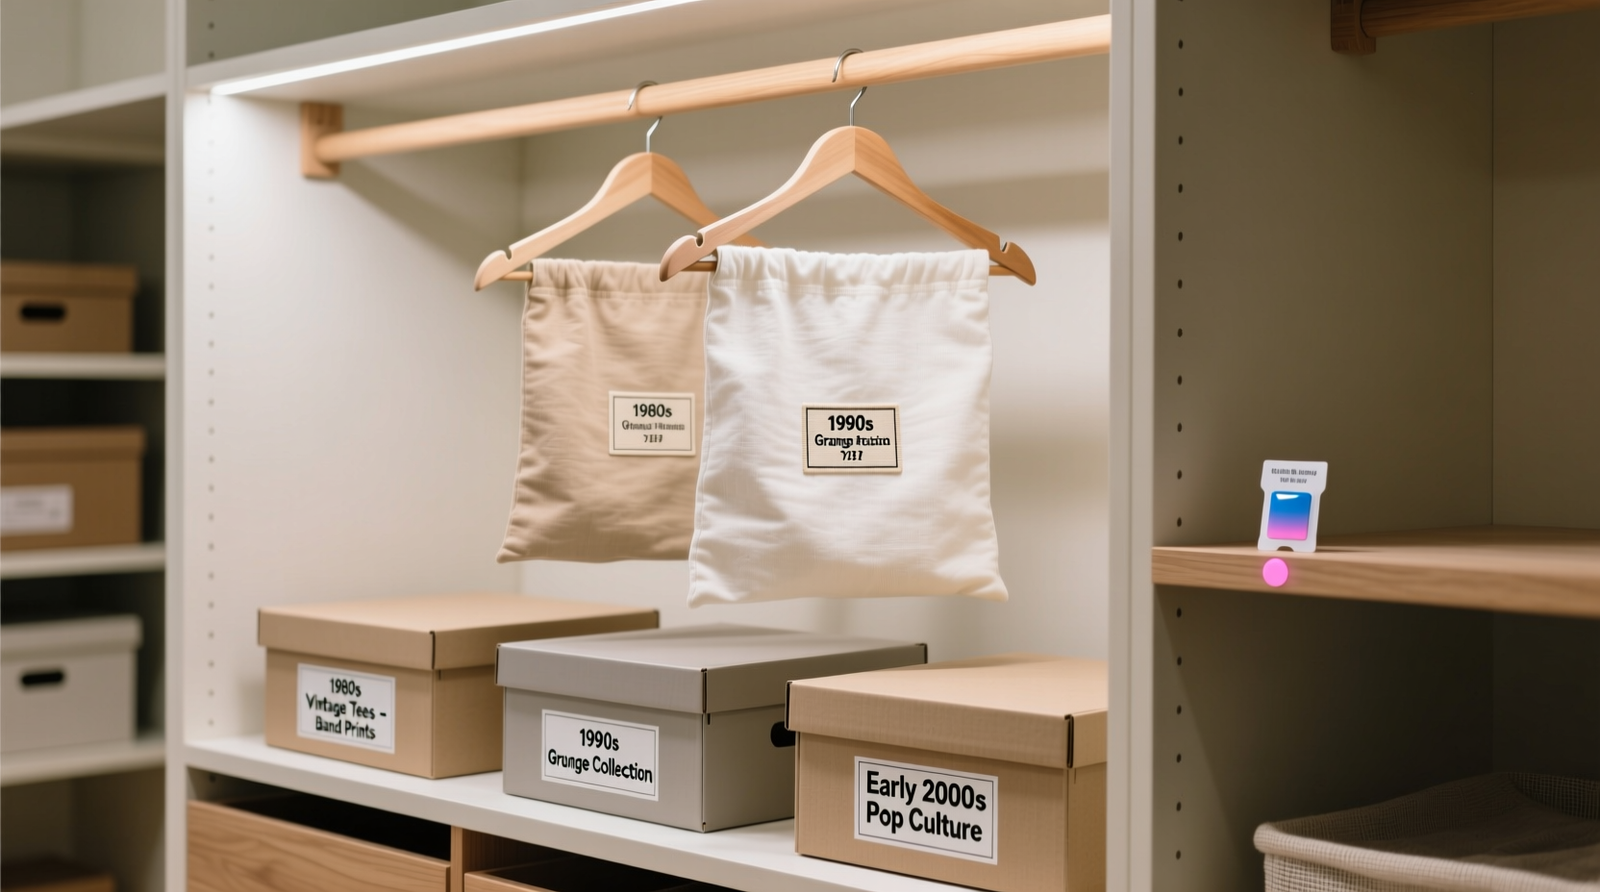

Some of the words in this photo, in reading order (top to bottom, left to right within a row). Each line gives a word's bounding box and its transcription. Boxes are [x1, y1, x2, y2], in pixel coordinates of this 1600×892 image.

[633, 404, 672, 417] 1980s
[828, 415, 874, 431] 1990s
[329, 677, 362, 697] 1980s
[349, 701, 376, 720] Tees
[315, 715, 342, 734] Band
[345, 719, 376, 740] Prints
[579, 728, 620, 751] 1990s
[548, 749, 590, 774] Grunge
[592, 755, 653, 784] Collection
[867, 770, 917, 806] Early
[922, 779, 987, 811] 2000s
[866, 800, 904, 834] Pop
[909, 807, 983, 842] Culture
